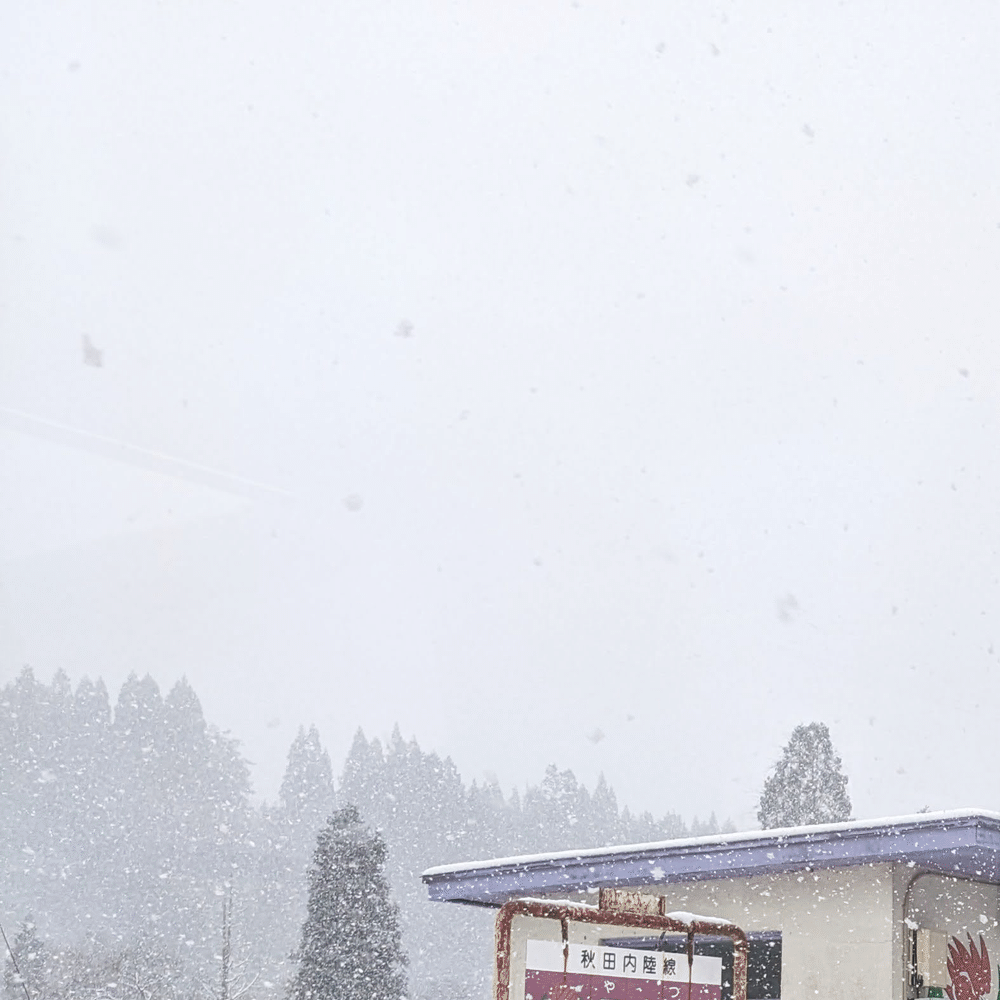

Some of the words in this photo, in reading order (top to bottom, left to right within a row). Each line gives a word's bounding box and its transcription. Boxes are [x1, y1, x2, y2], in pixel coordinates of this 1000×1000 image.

[580, 949, 677, 976] 秋田内陸線
[604, 980, 616, 993] や
[668, 986, 680, 998] つ
